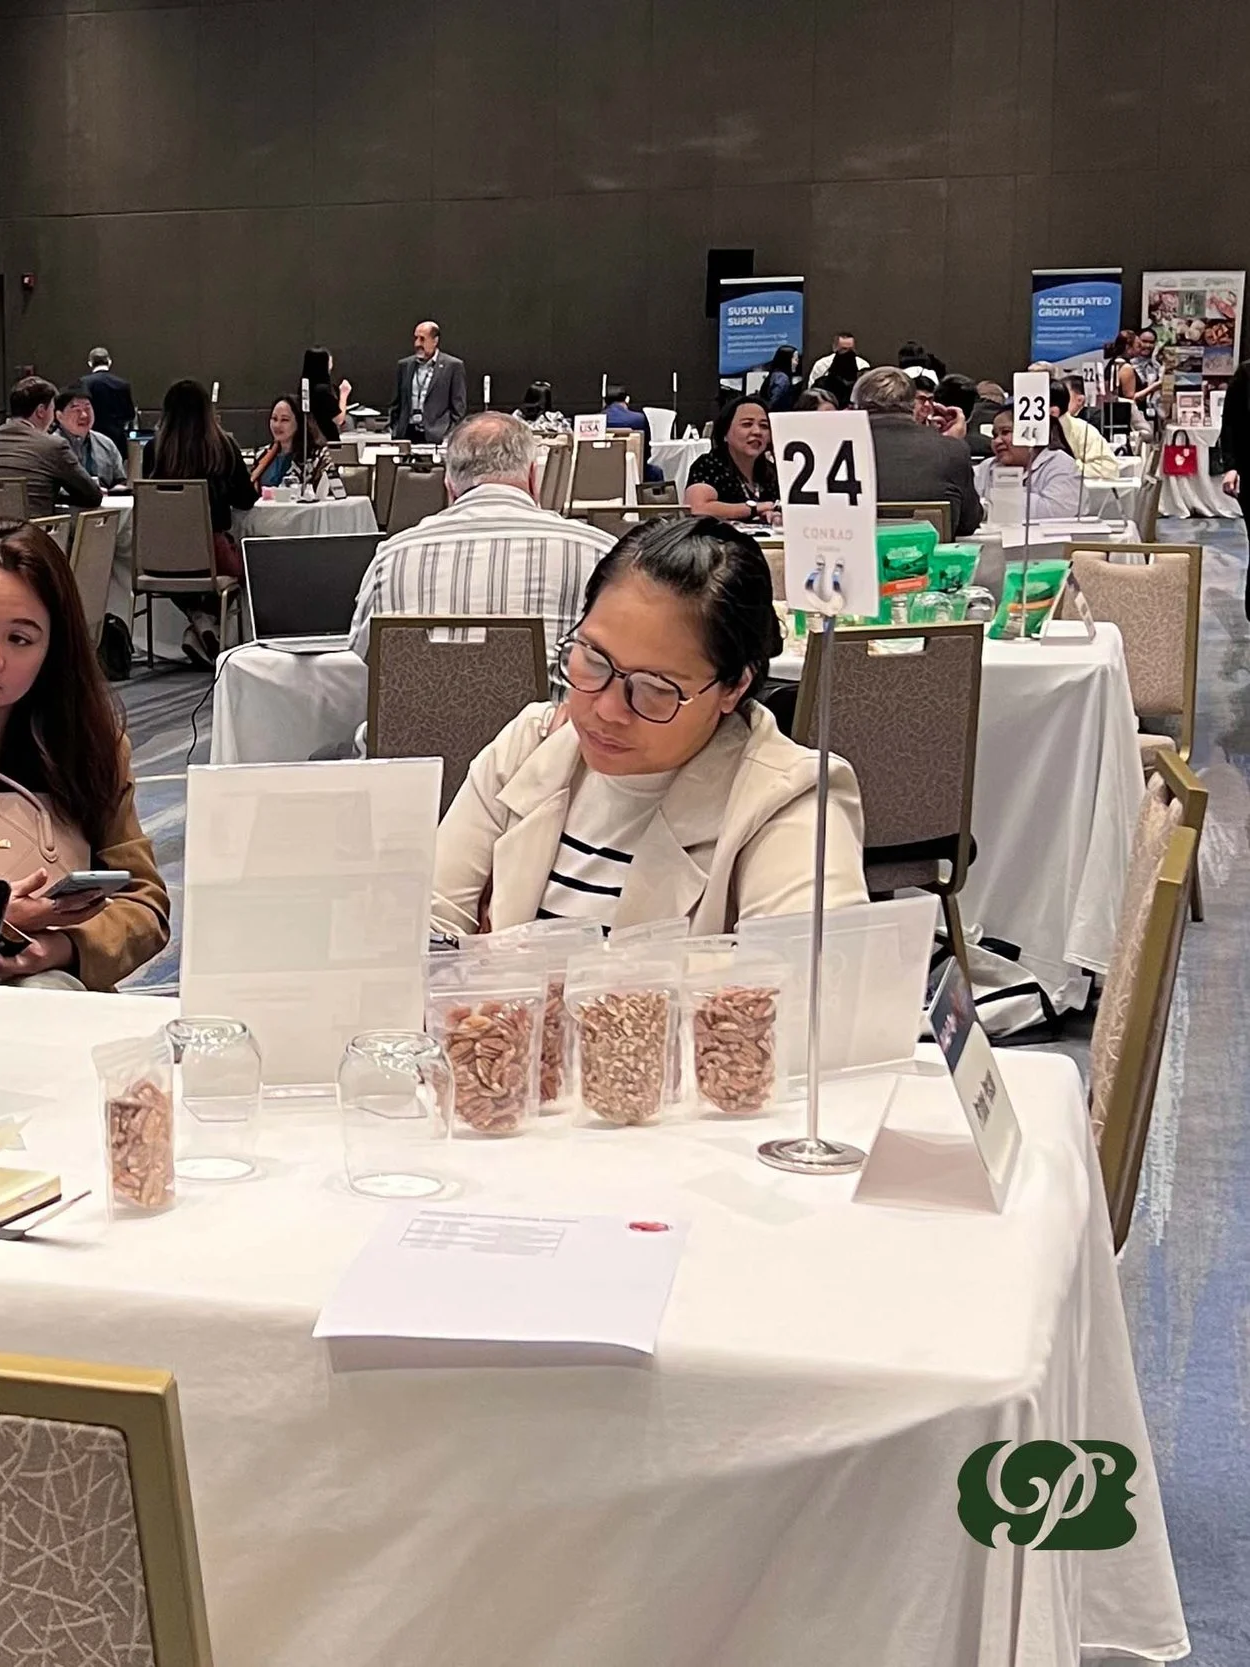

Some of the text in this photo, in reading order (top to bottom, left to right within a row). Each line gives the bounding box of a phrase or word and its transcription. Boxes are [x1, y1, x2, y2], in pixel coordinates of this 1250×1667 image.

[1038, 296, 1112, 307] ACCELERATED
[727, 304, 795, 316] SUSTAINABLE
[1038, 307, 1085, 317] GROWTH
[727, 316, 766, 326] SUPPLY
[1083, 368, 1095, 383] 22
[1019, 396, 1046, 422] 23
[580, 424, 599, 433] USA
[783, 439, 862, 507] 24
[802, 526, 854, 541] CONRAD
